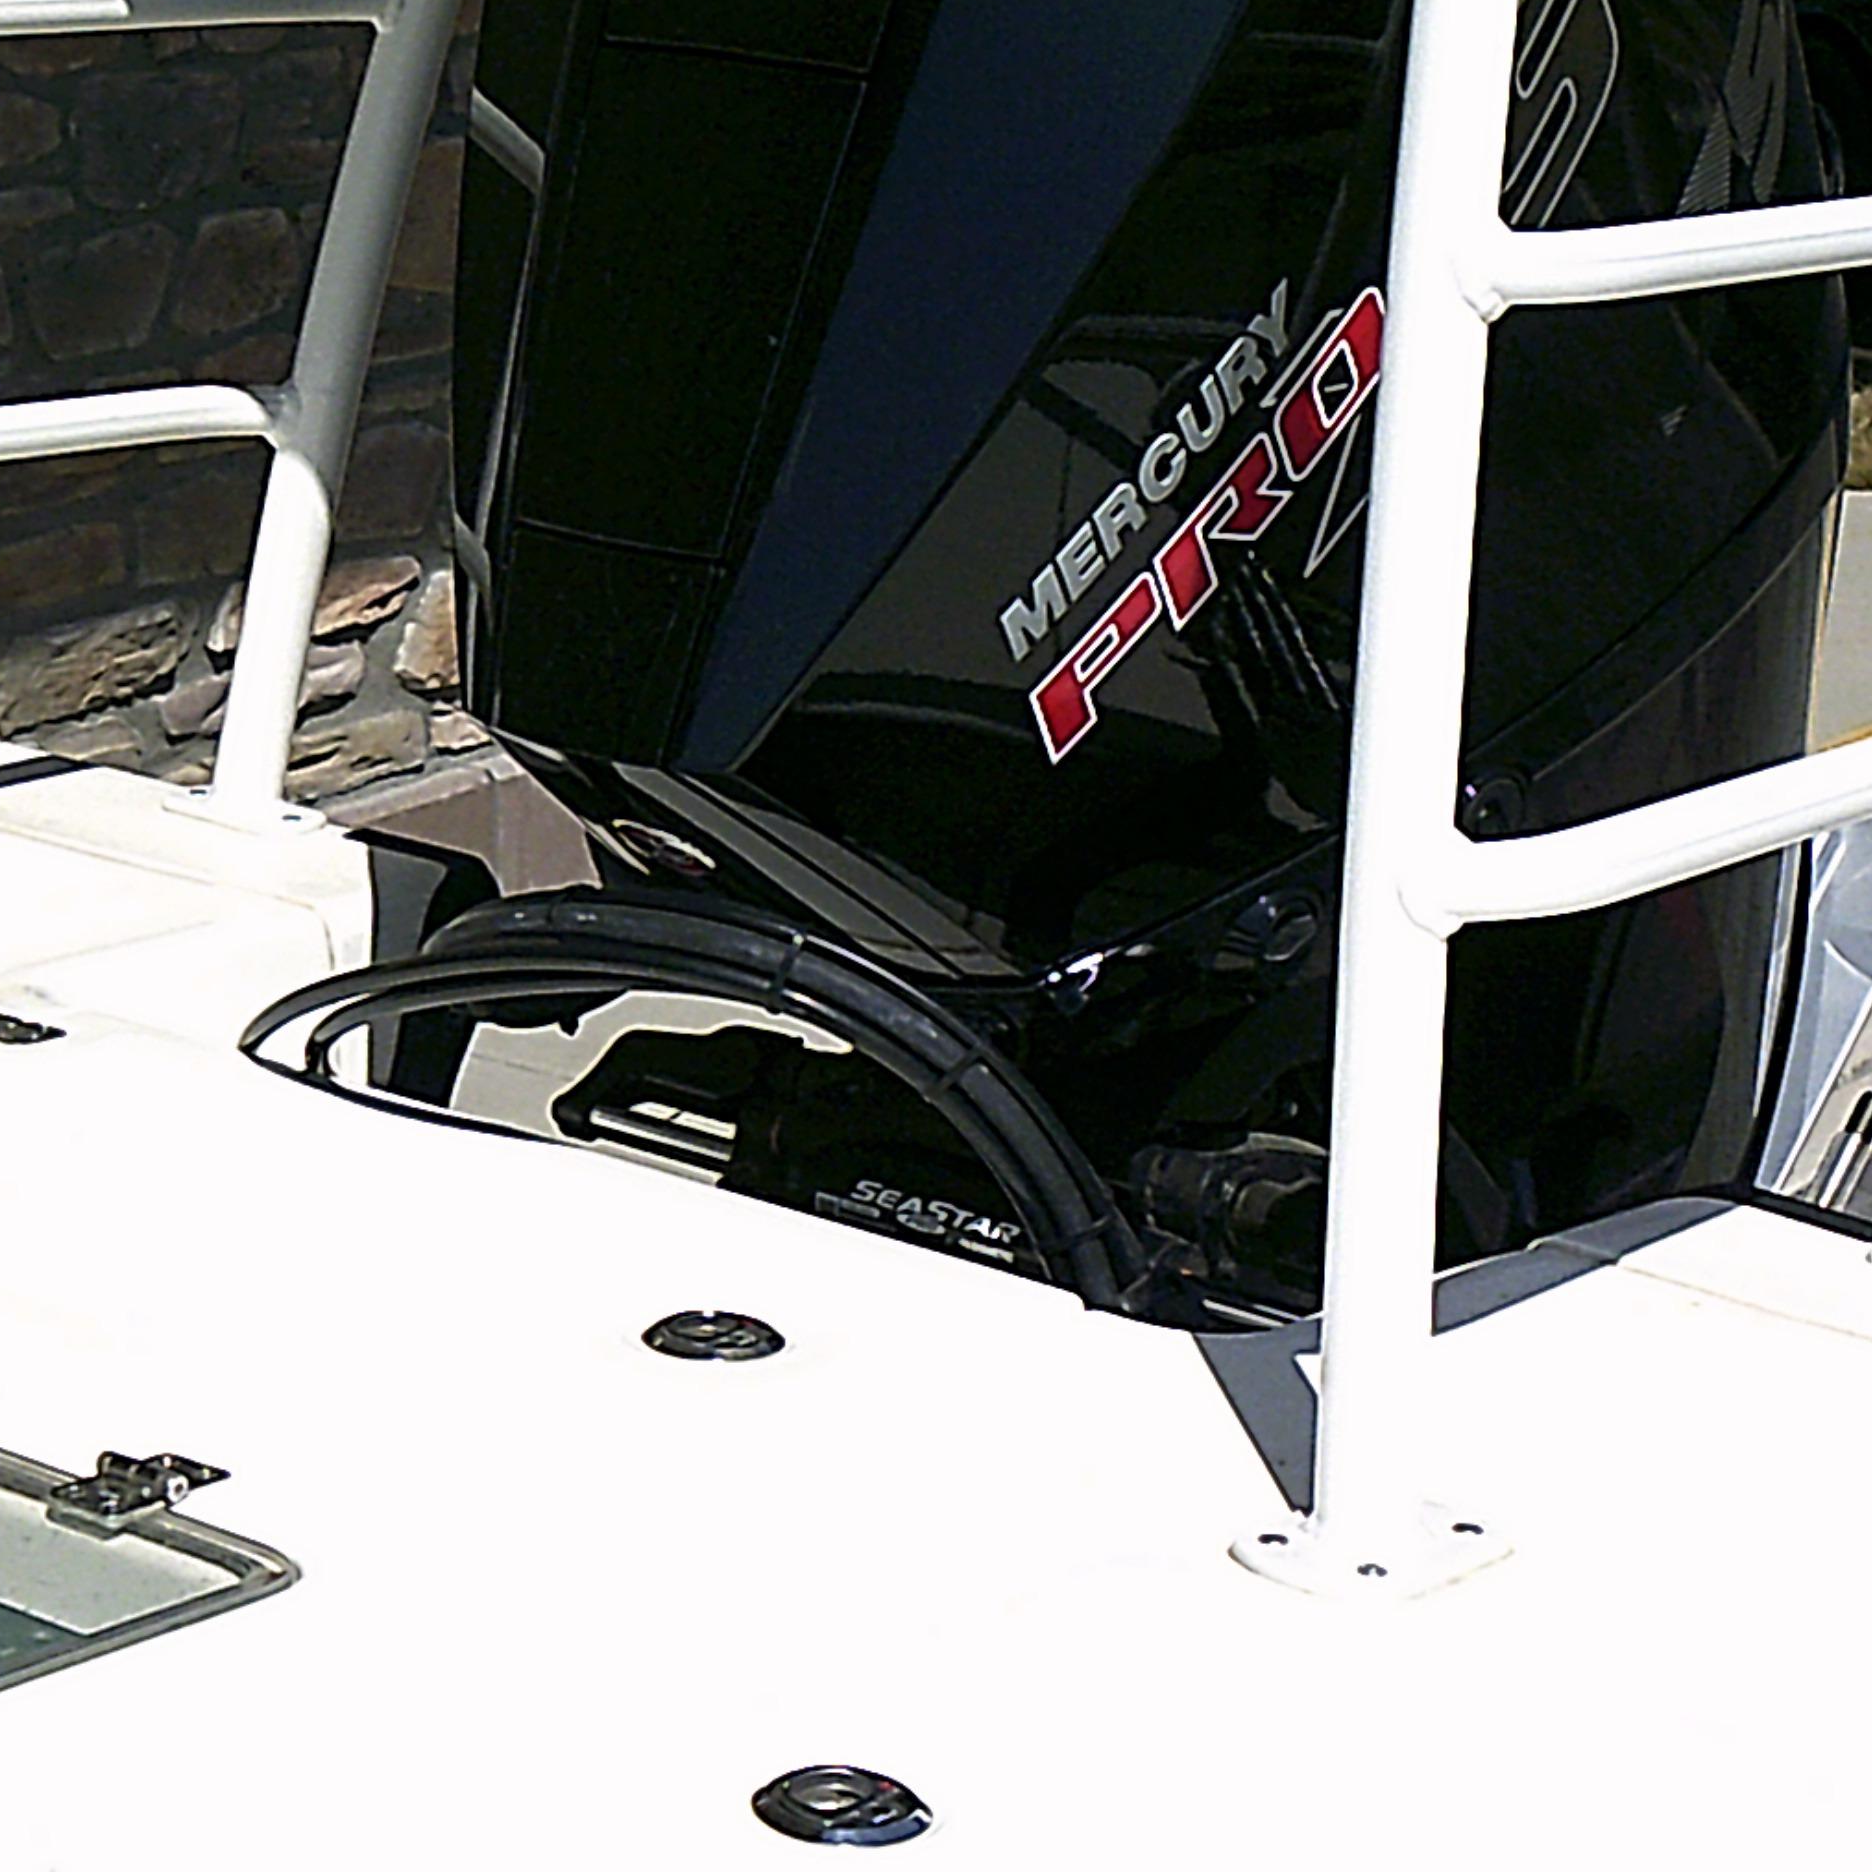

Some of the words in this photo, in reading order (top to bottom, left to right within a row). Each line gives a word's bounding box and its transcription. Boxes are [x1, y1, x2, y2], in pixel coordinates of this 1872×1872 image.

[997, 276, 1291, 664] MERCURY
[1028, 284, 1387, 768] PRO
[849, 1178, 1022, 1245] SEASTAR
